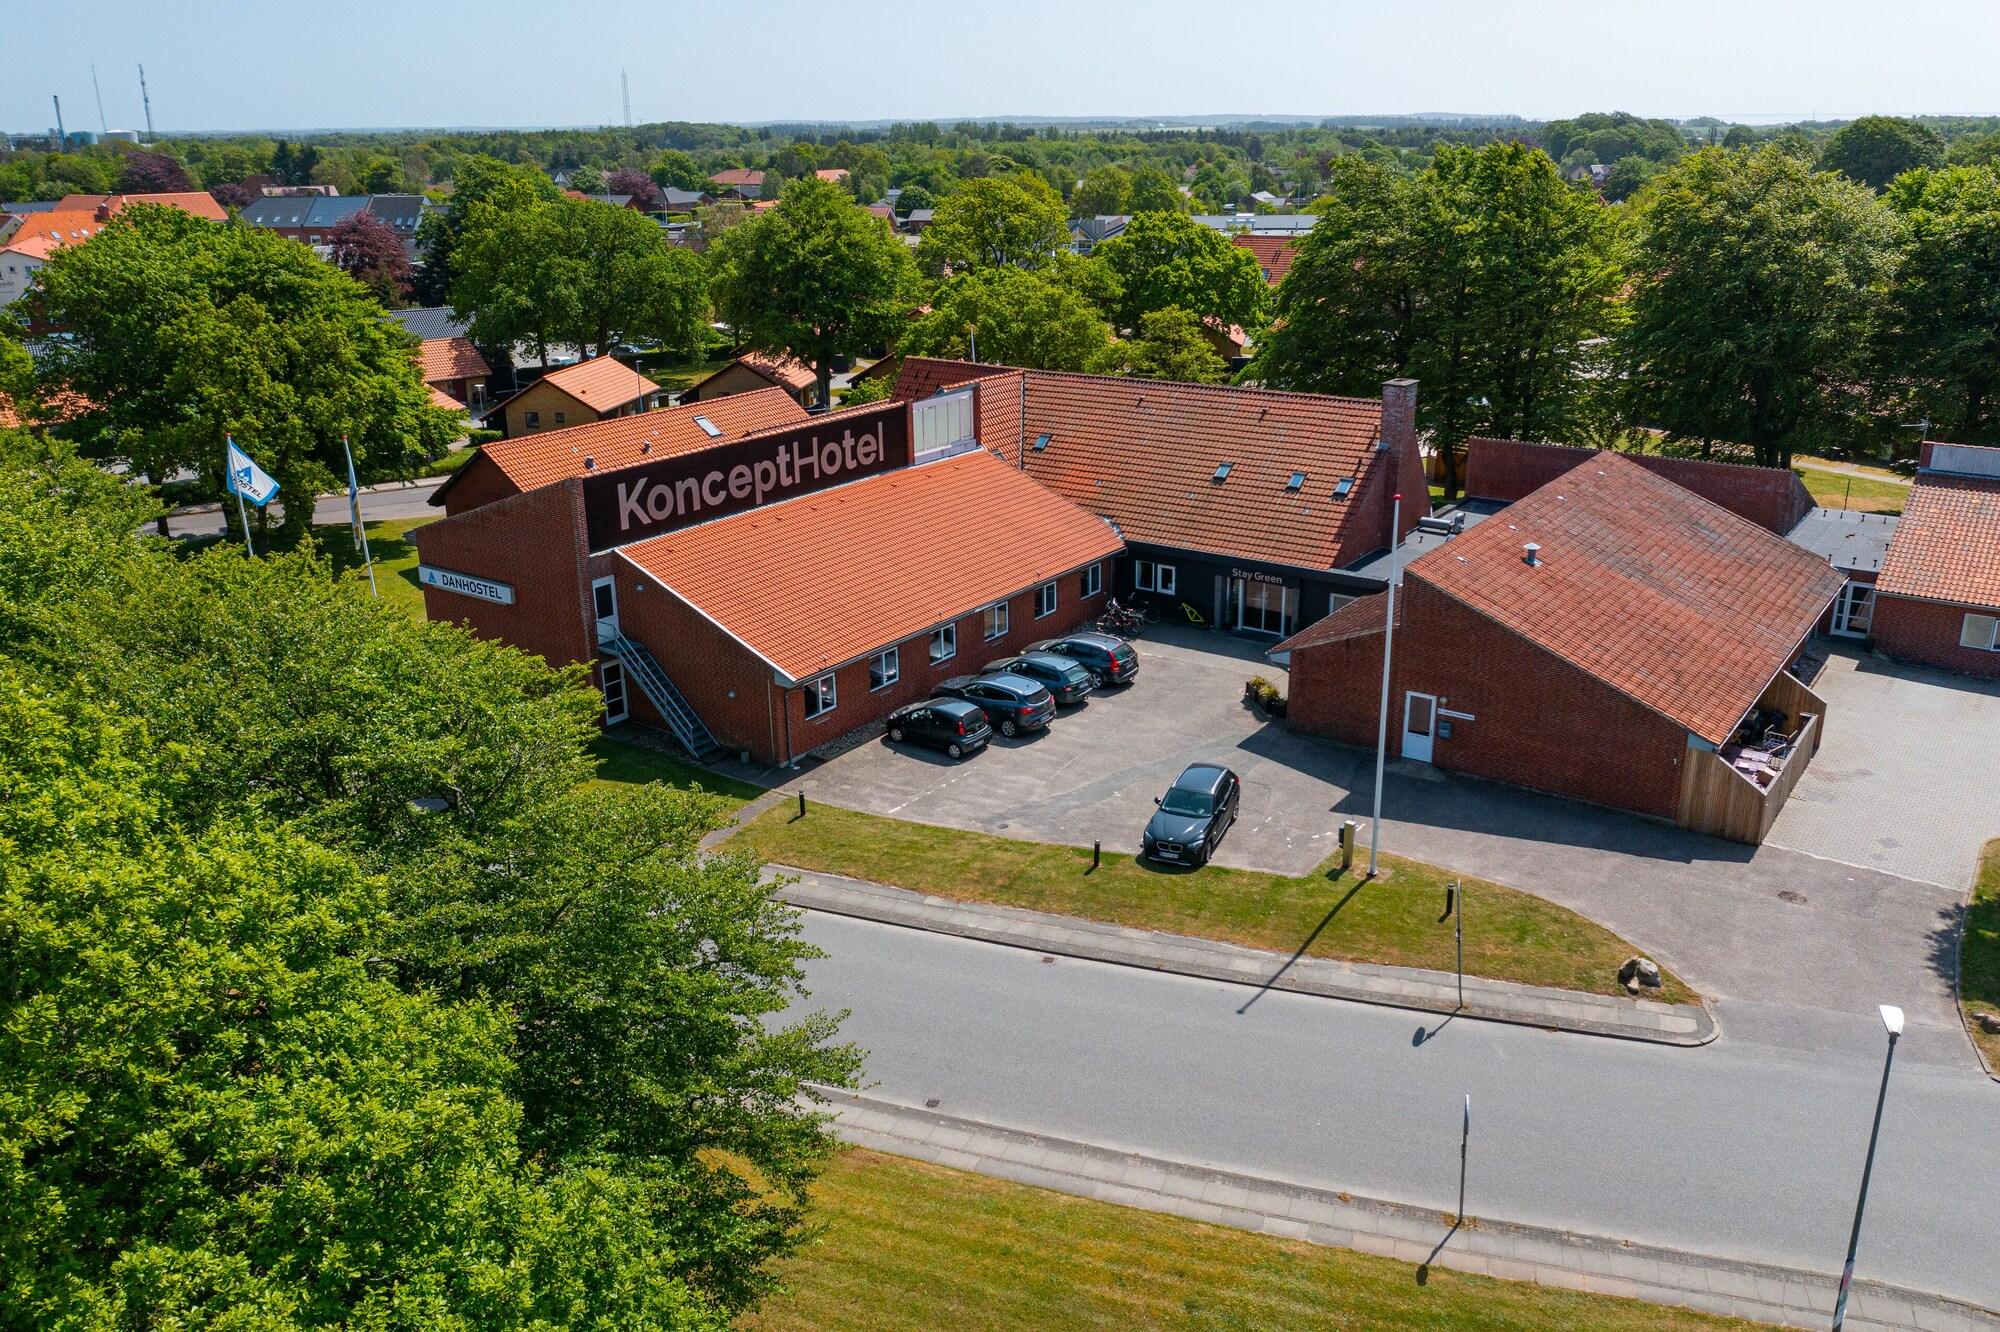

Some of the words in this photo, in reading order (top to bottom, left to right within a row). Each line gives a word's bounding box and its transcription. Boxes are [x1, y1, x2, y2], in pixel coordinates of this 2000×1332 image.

[617, 421, 884, 531] KonceptHotel
[441, 574, 503, 600] DANHOSTEL
[1231, 567, 1253, 581] Stay
[1254, 571, 1283, 584] Green
